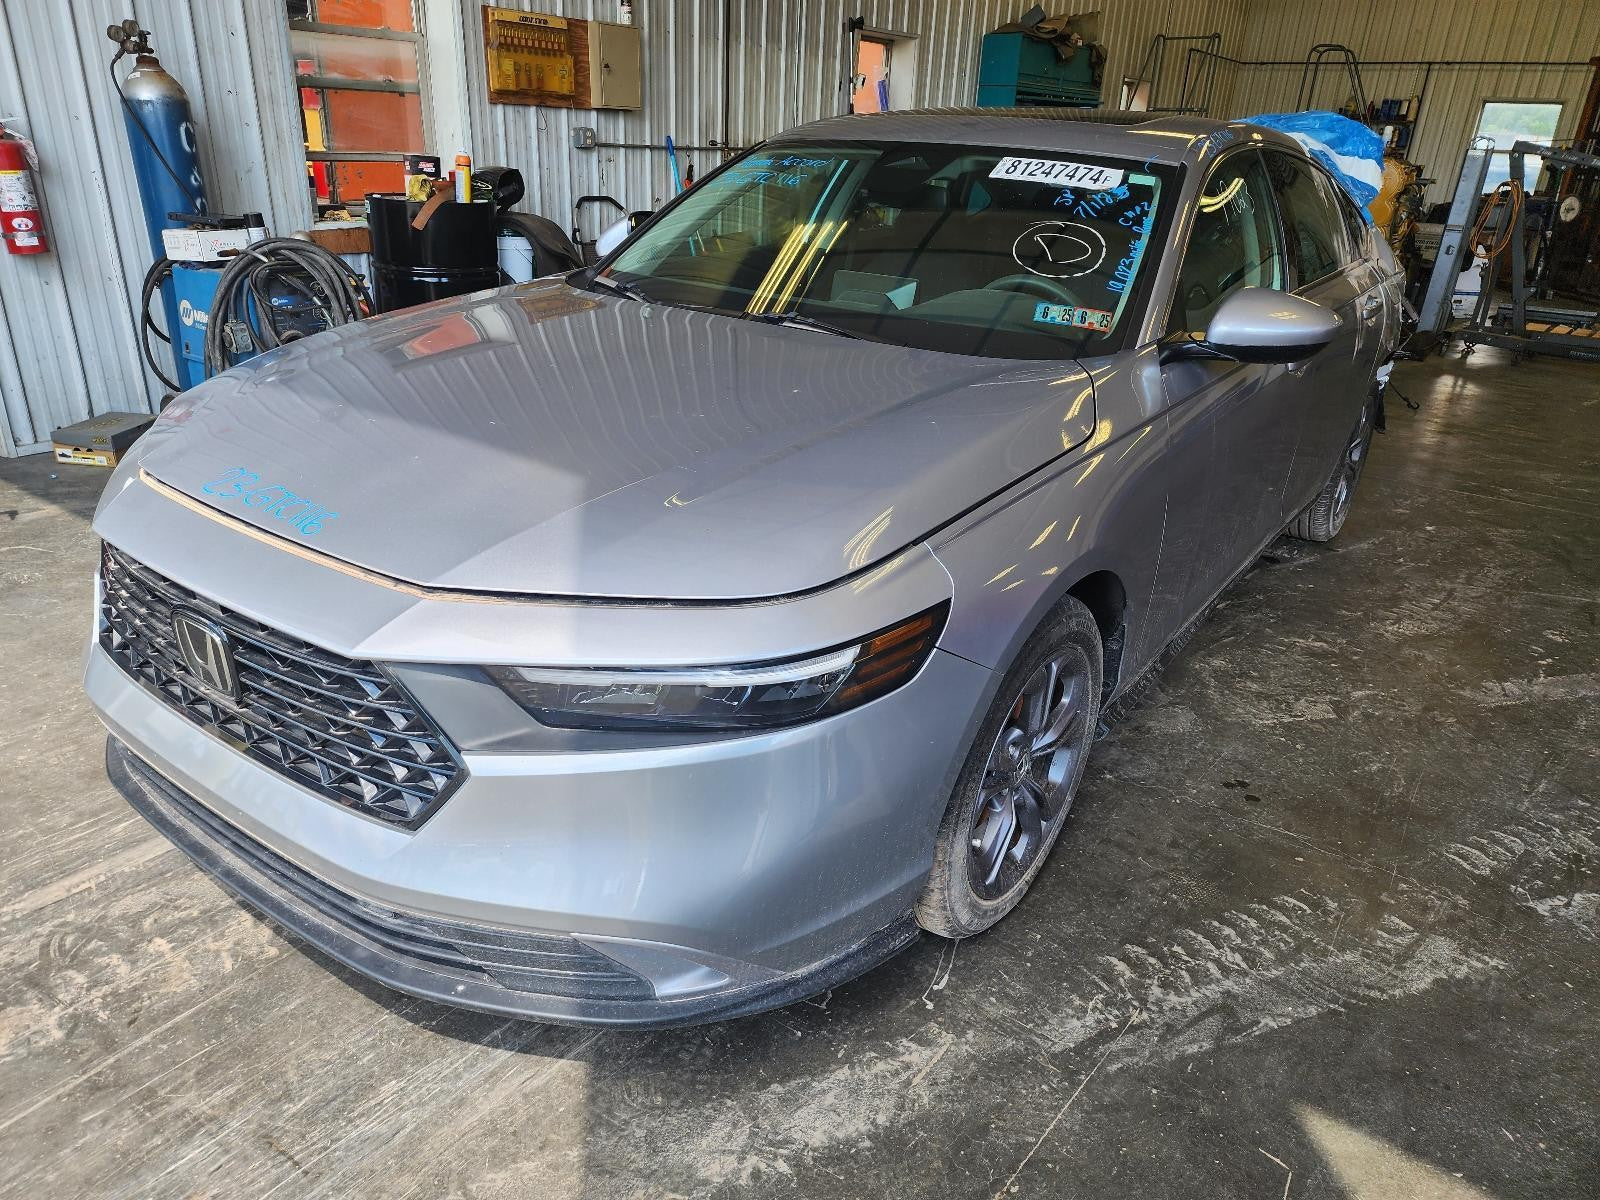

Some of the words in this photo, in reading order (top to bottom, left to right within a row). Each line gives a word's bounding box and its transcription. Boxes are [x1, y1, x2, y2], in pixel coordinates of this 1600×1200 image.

[1041, 306, 1050, 319] 6
[1061, 308, 1073, 322] 25
[1080, 310, 1088, 324] 6
[1100, 313, 1111, 328] 25
